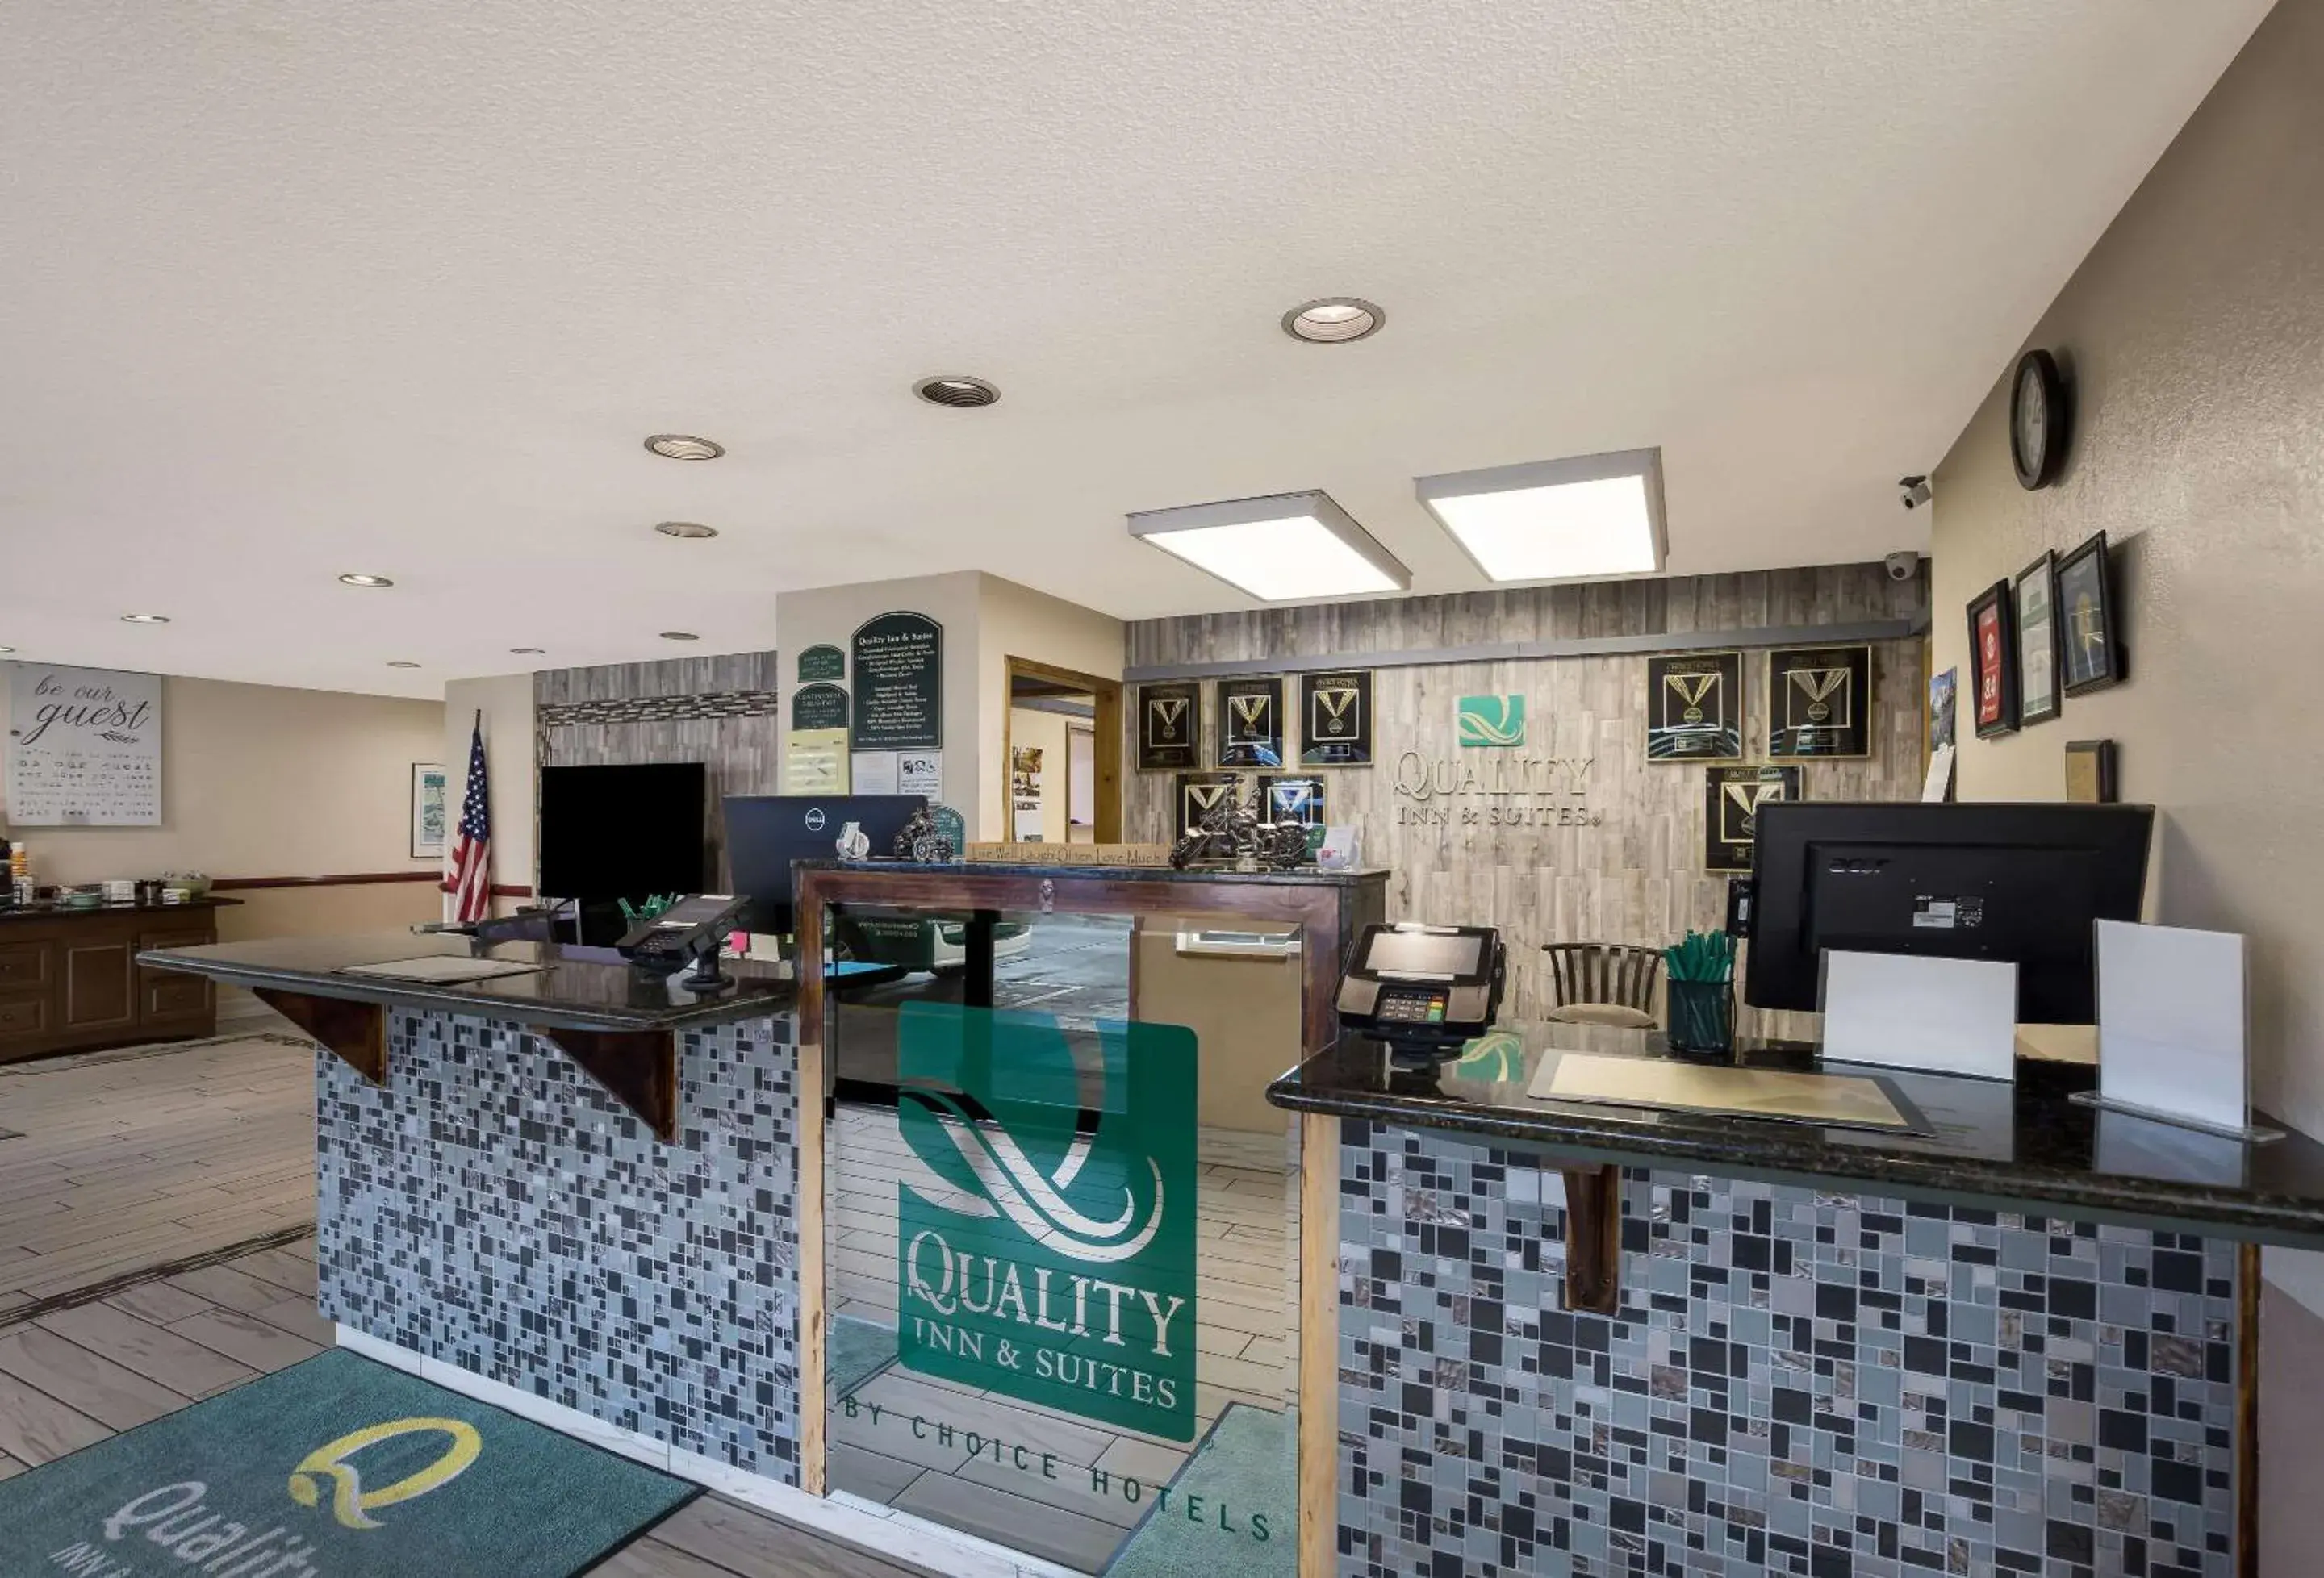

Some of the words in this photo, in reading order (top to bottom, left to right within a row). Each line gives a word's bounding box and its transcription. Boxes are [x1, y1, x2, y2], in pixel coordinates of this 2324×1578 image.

[859, 636, 885, 646] Quality
[887, 634, 900, 643] Inn
[901, 632, 909, 642] &
[911, 632, 933, 641] Suites
[35, 674, 64, 696] be
[74, 685, 115, 702] our
[20, 700, 151, 745] guest
[1392, 752, 1595, 800] QUALITY
[1397, 807, 1449, 826] INN
[1461, 807, 1478, 825] &
[1096, 848, 1124, 863] Love
[1127, 849, 1160, 865] Much
[907, 1230, 1185, 1357] QUALITY
[914, 1317, 984, 1362] INN
[997, 1338, 1021, 1370] &
[1035, 1349, 1177, 1409] SUITES
[845, 1396, 883, 1426] BY
[912, 1415, 1057, 1480] CHOICE
[1092, 1467, 1270, 1543] HOTELS
[105, 1481, 317, 1578] Qualit
